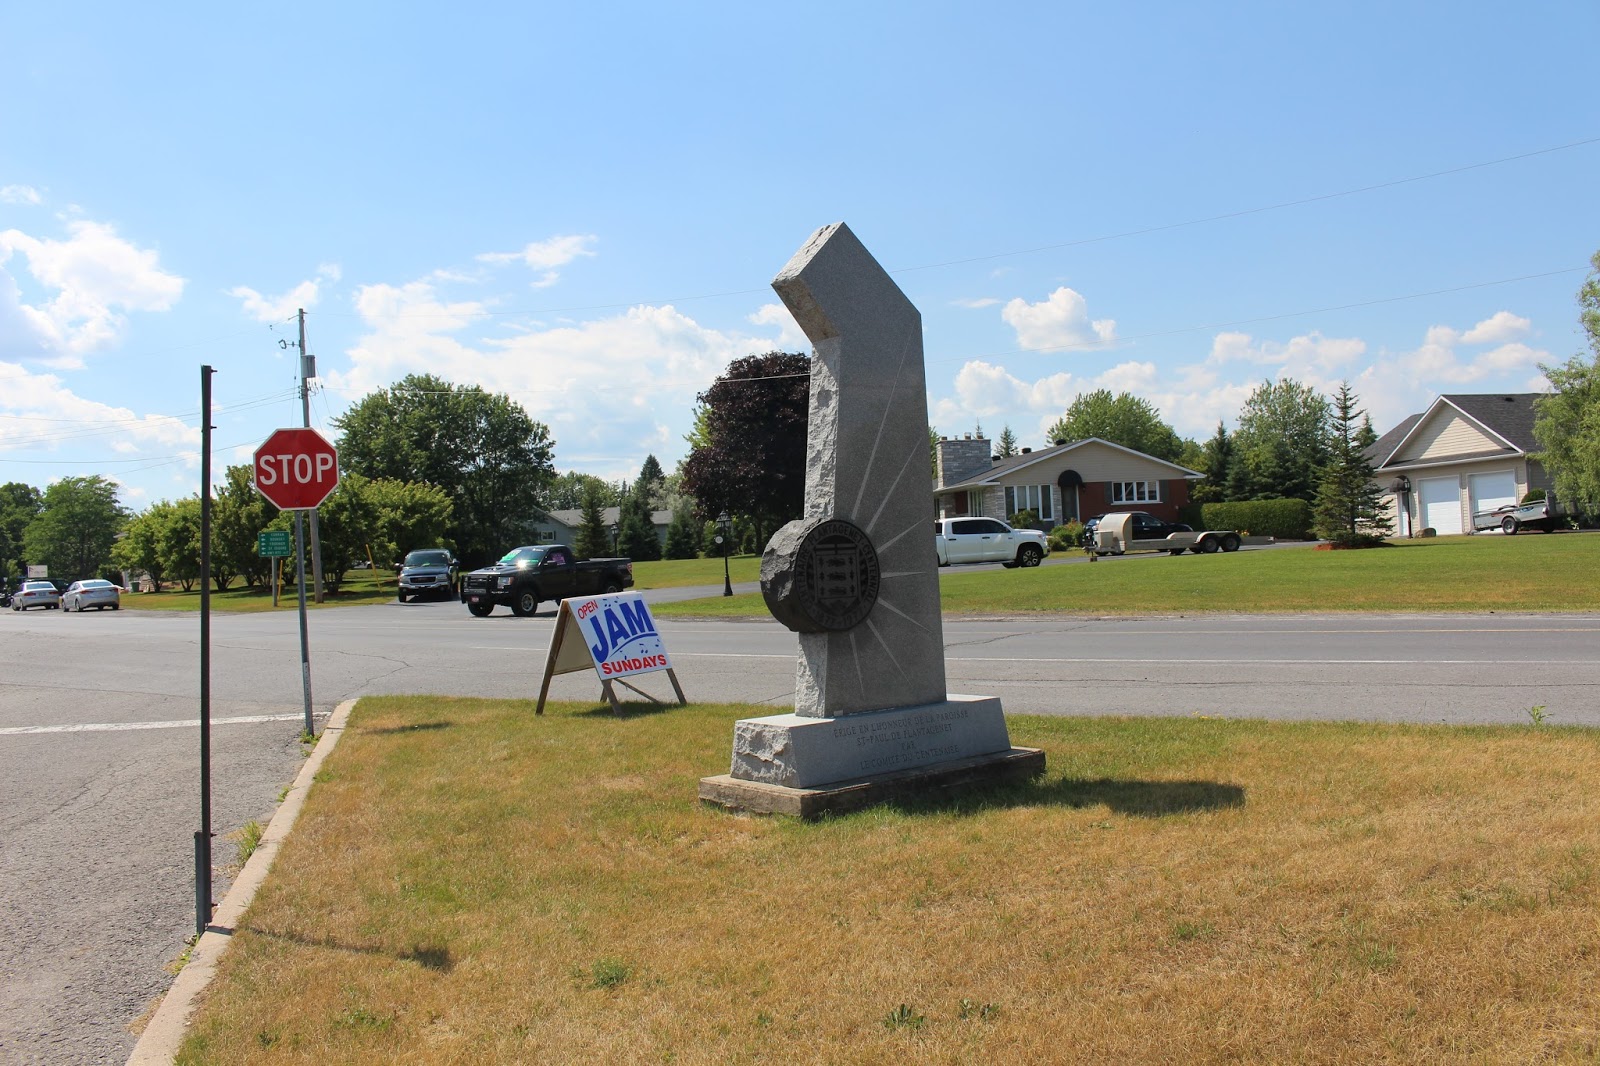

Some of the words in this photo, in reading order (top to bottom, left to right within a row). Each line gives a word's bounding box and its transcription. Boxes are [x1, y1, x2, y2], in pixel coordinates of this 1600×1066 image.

[259, 453, 334, 486] STOP
[808, 523, 864, 545] PLANTAGENET
[862, 544, 878, 604] CENTENNIAL
[577, 599, 599, 620] OPEN
[589, 599, 655, 664] JAM
[601, 654, 667, 675] SUNDAYS
[859, 724, 870, 734] EN
[914, 717, 925, 726] DE
[926, 715, 935, 724] LA
[936, 710, 969, 722] PAROISSE
[857, 733, 889, 746] ST-PAUL
[891, 731, 901, 740] DE
[903, 723, 952, 739] PLANTAGENET
[860, 759, 871, 770] LE
[903, 753, 913, 762] DU
[915, 745, 959, 760] CENTENAIRE
[901, 741, 917, 752] PAR
